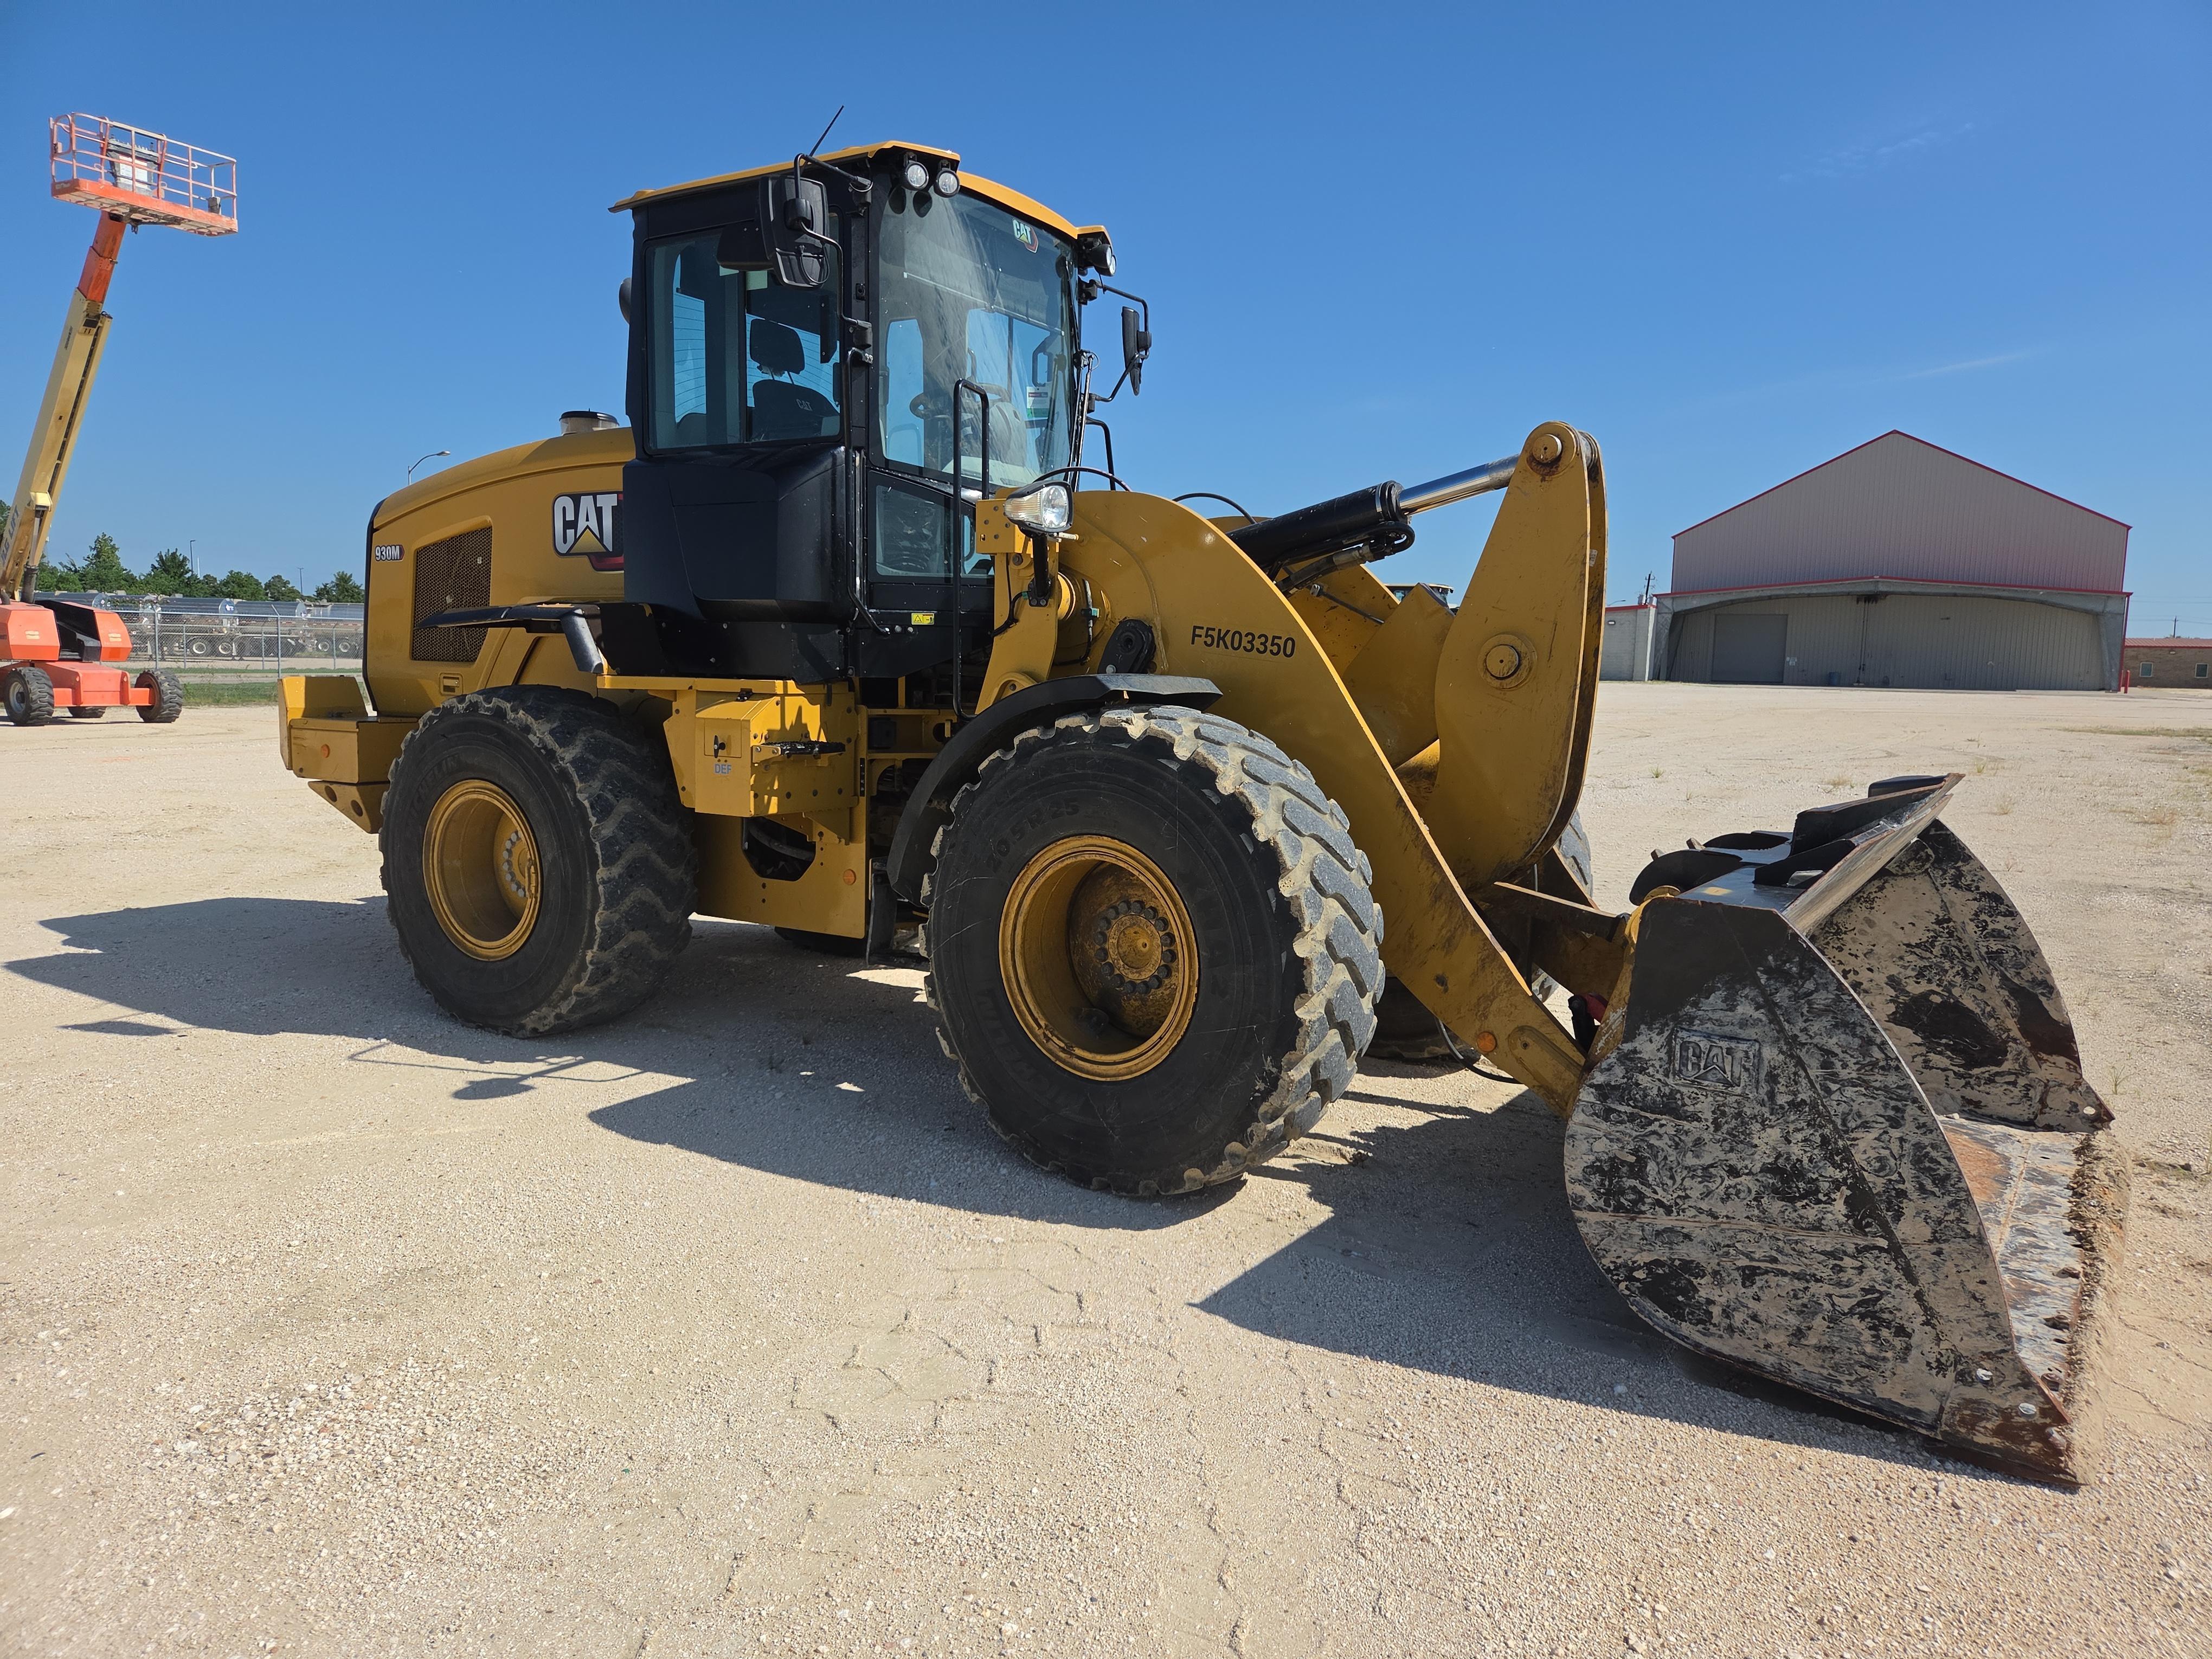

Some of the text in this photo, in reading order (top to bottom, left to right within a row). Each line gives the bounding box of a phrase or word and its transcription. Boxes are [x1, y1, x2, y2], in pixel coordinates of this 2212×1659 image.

[1013, 220, 1031, 244] CAT
[796, 399, 812, 411] CAT
[554, 494, 617, 554] CAT
[375, 545, 400, 560] 930M
[1191, 626, 1295, 658] F5K03350
[715, 764, 731, 774] DEF
[1679, 1041, 1749, 1087] CAT
